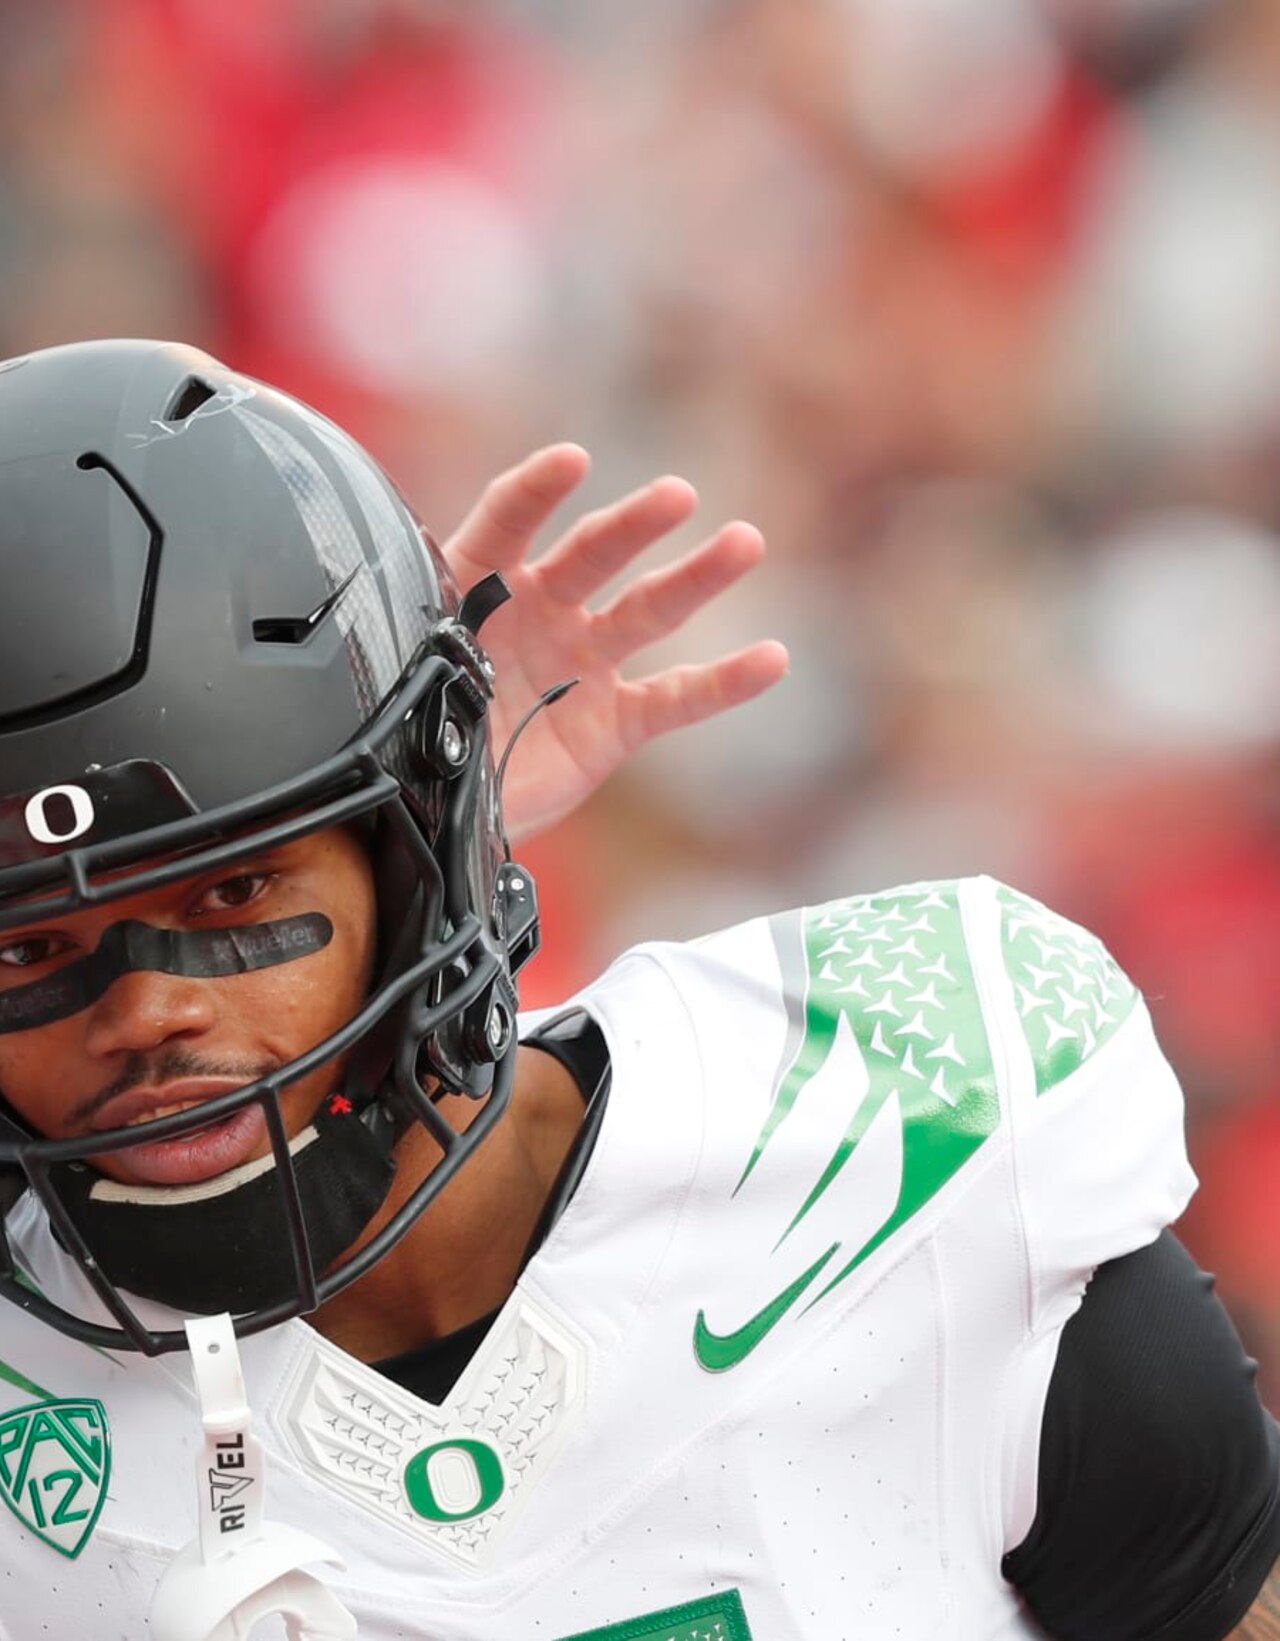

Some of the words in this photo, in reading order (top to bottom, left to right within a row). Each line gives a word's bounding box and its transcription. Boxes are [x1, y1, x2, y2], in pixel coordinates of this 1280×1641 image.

[24, 784, 95, 844] O
[28, 1469, 91, 1529] 12
[208, 1432, 255, 1534] RIVEL
[404, 1438, 505, 1523] O
